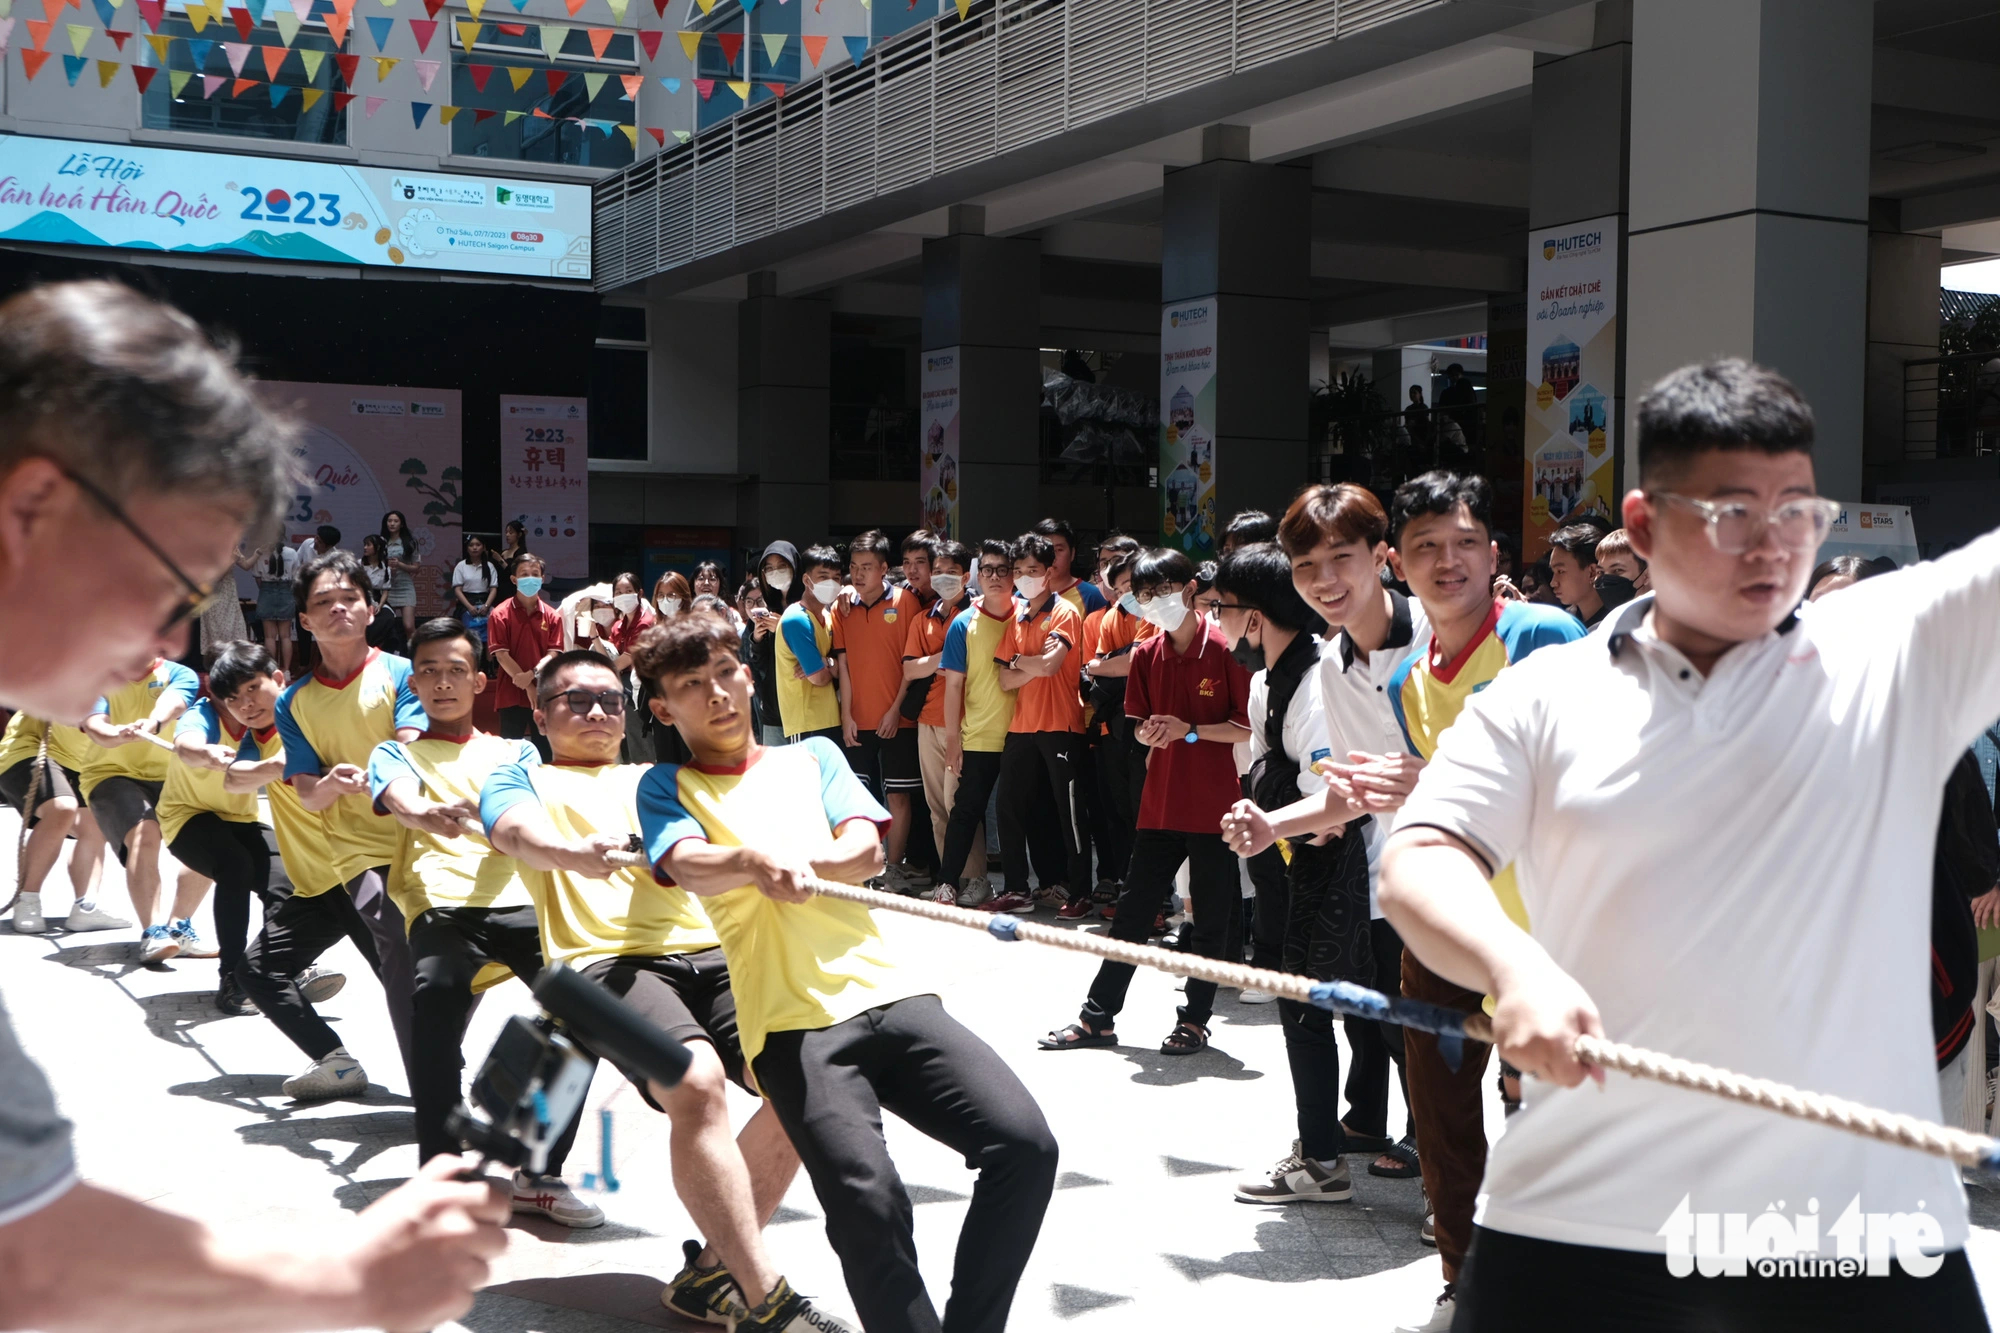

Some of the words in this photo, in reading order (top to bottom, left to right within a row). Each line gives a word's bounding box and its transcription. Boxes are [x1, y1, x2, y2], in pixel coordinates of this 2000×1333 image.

[57, 151, 91, 177] Lễ
[92, 156, 145, 183] Hội
[39, 182, 85, 210] hoá
[90, 181, 148, 216] Hàn
[152, 189, 222, 227] Quốc
[240, 186, 341, 227] 2023
[474, 230, 506, 239] 07/7/2023
[516, 233, 538, 242] 08g30
[1557, 231, 1601, 253] HUTECH
[458, 240, 486, 248] HUTECH
[487, 242, 509, 251] Saigon
[510, 244, 535, 252] Campus
[1179, 306, 1208, 322] HUTECH
[933, 355, 954, 367] HUTECH
[525, 427, 565, 443] 2023
[522, 446, 565, 473] 휴텍
[315, 464, 361, 492] Quốc
[1873, 517, 1894, 525] STARS
[1199, 689, 1214, 697] BKC
